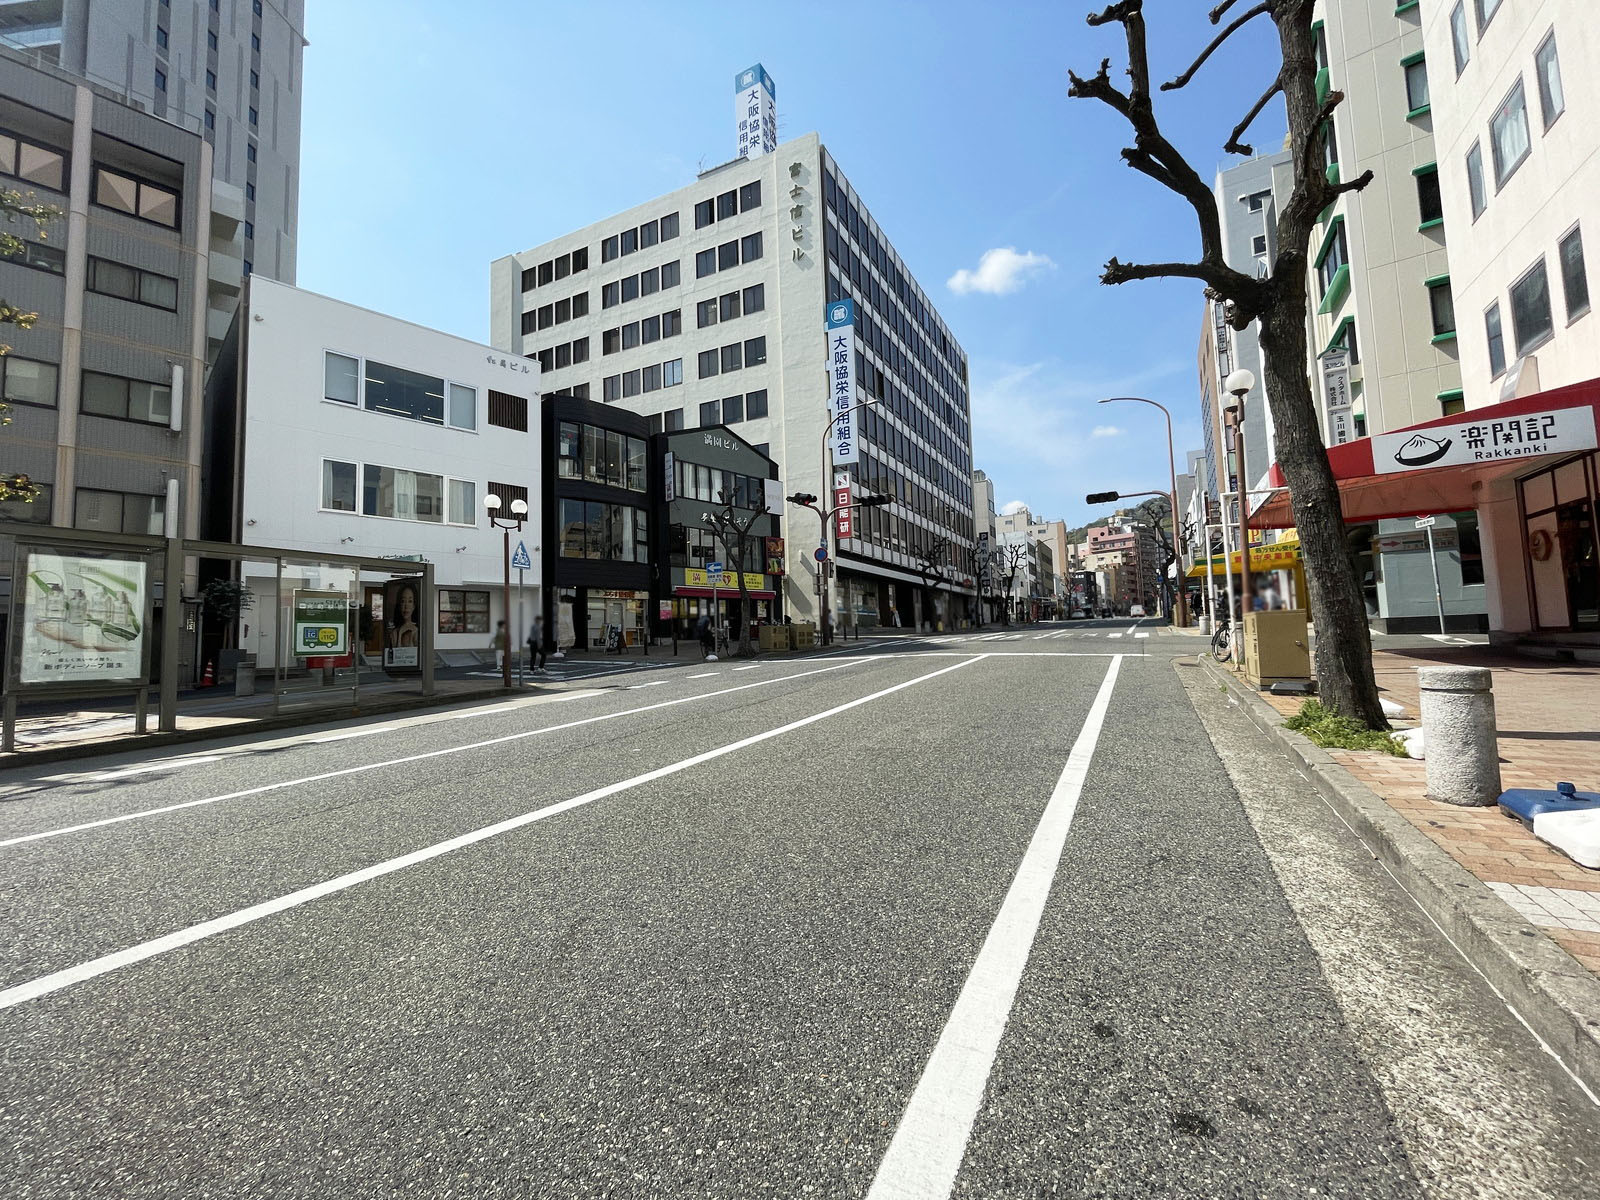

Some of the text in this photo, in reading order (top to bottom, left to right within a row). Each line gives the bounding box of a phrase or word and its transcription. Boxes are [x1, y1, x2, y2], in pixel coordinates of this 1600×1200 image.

[748, 89, 760, 149] 大阪協栄
[834, 335, 851, 456] 大阪協栄信用組合
[1337, 416, 1346, 443] 玉川歯科
[1475, 443, 1547, 460] Rakkanki
